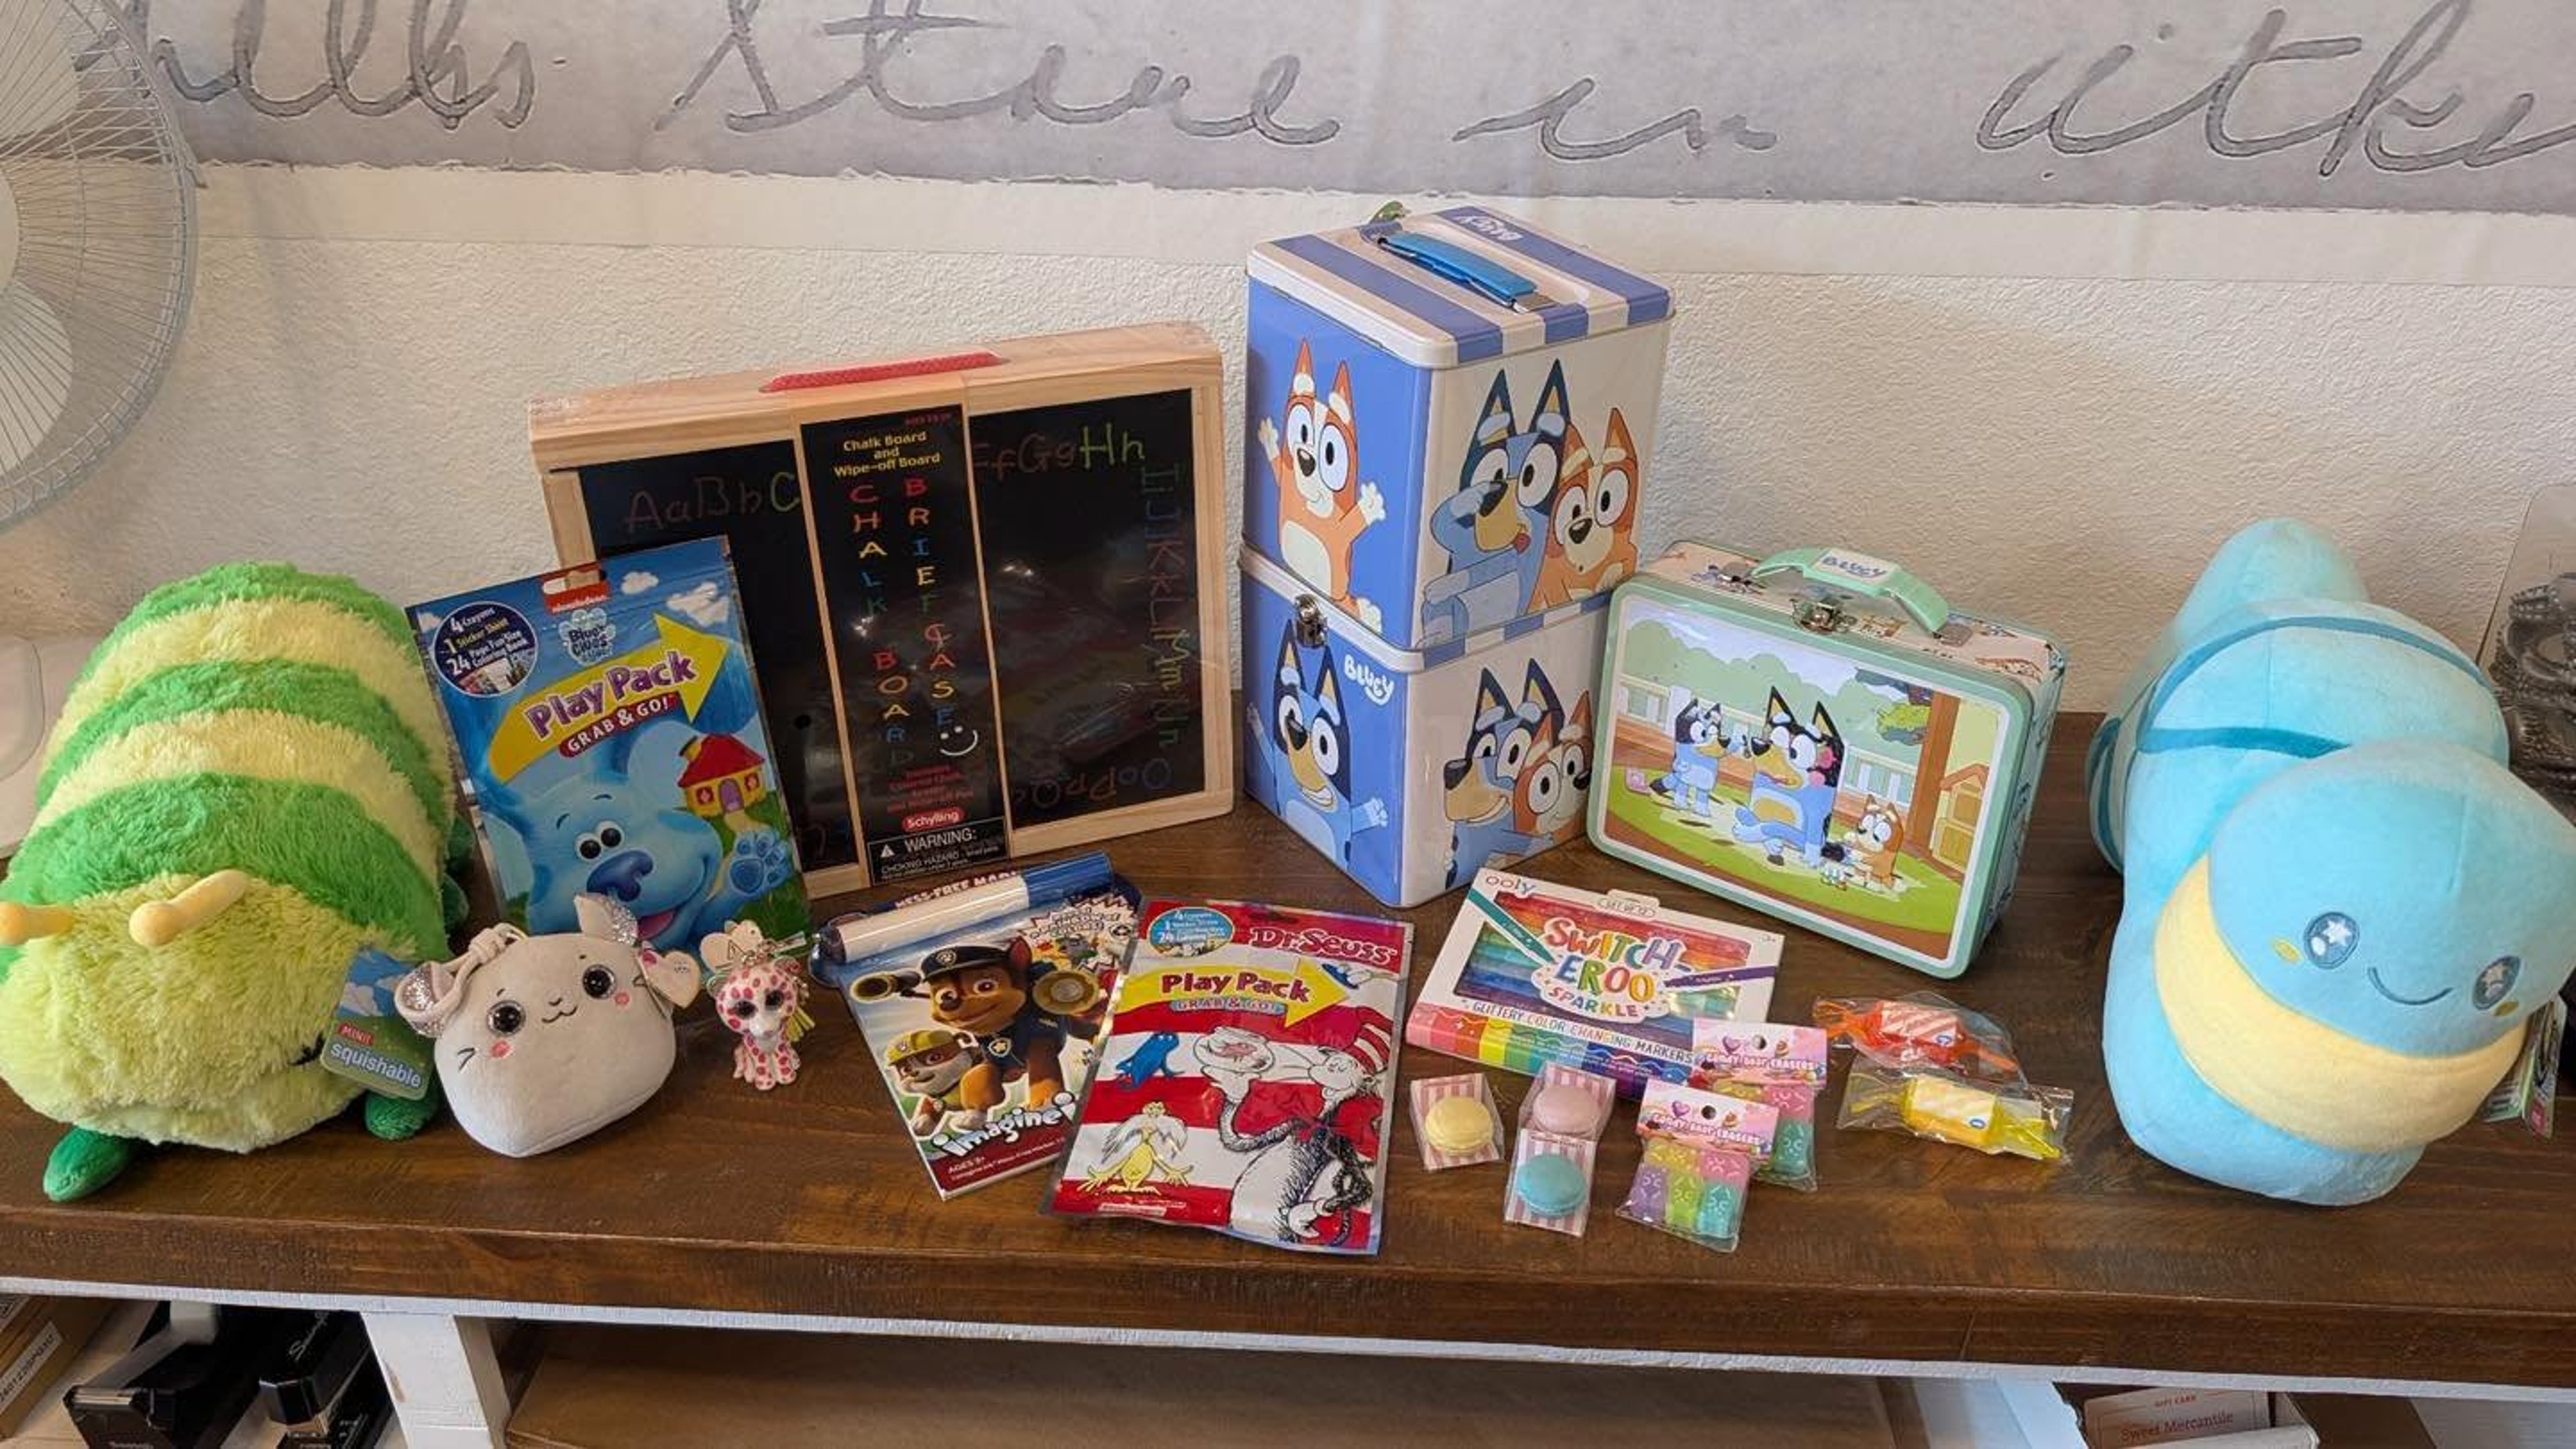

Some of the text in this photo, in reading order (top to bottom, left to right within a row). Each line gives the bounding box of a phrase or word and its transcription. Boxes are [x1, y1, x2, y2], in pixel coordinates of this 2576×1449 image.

[843, 431, 927, 452] Chalk Board
[874, 447, 900, 460] and
[835, 452, 941, 478] Wipe-off Board
[443, 638, 458, 654] 1
[446, 654, 471, 676] 24
[525, 649, 698, 739] Play Pack
[567, 698, 669, 753] GRAB & GO!
[904, 828, 977, 853] WARNING:
[1485, 875, 1536, 894] ooly
[1248, 926, 1299, 953] Dr.
[1297, 928, 1391, 965] Seuss
[1544, 918, 1692, 972] SWITCH-
[1161, 971, 1311, 1003] Play Pack
[1555, 954, 1656, 1002] EROO
[1178, 1000, 1225, 1010] GRAB
[1228, 997, 1240, 1008] &
[1549, 986, 1640, 1018] SPARKLE
[1473, 1002, 1523, 1022] GLITTERY
[1527, 1014, 1566, 1030] COLOR
[1570, 1023, 1632, 1049] CHANGING
[1634, 1040, 1693, 1063] MARKERS
[330, 1043, 422, 1088] squishable
[2120, 1411, 2234, 1442] Sweet Mercantile
